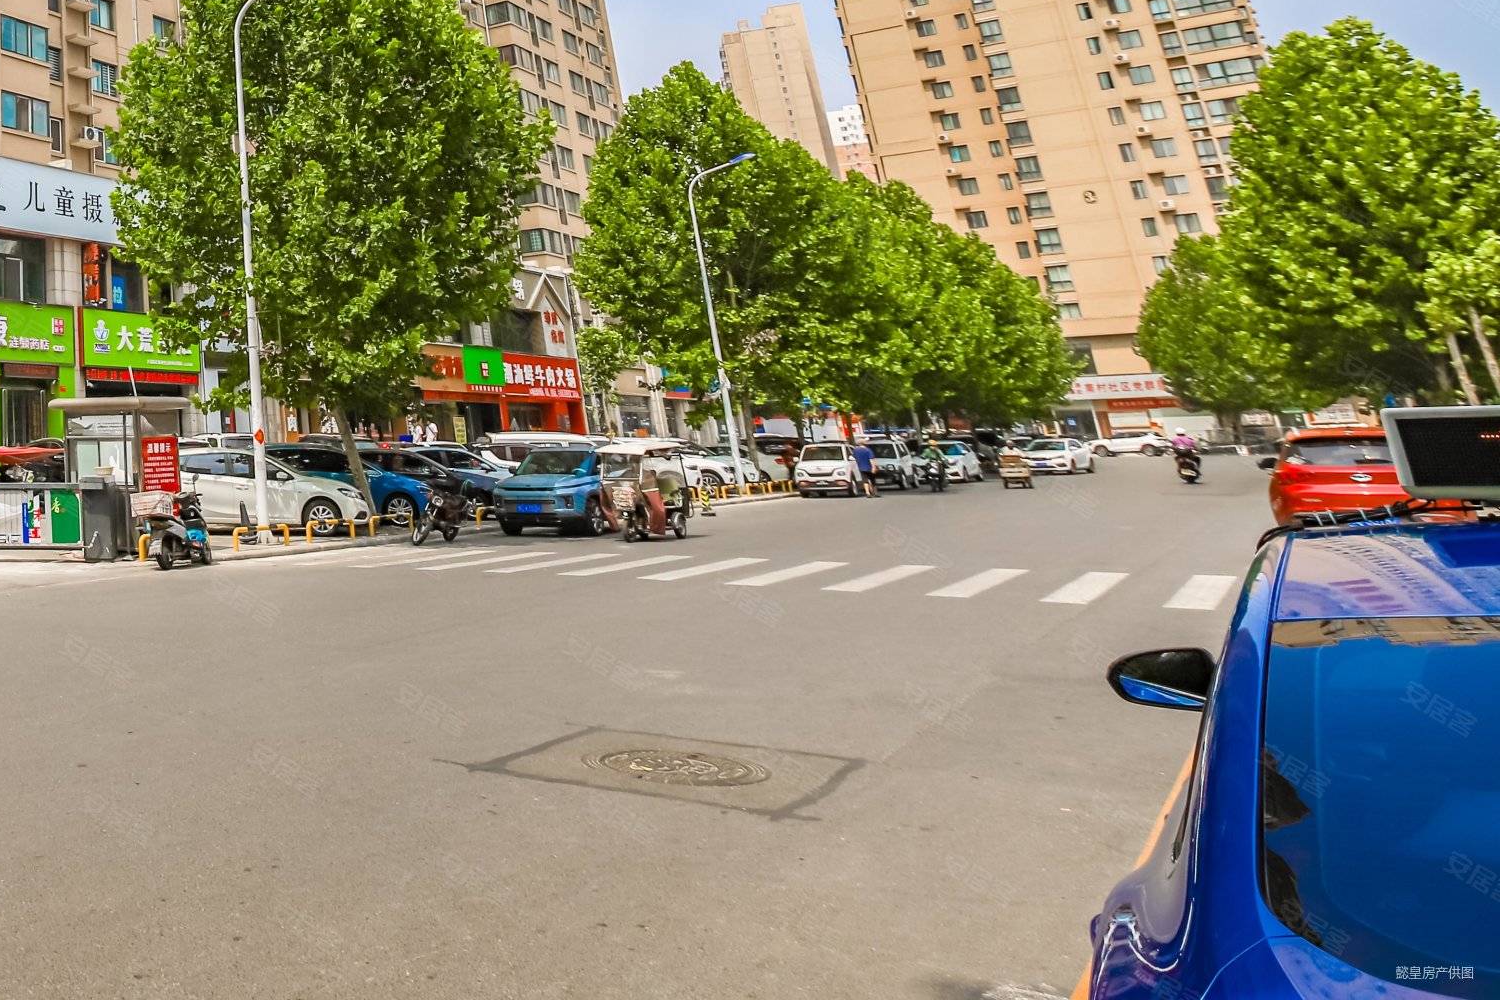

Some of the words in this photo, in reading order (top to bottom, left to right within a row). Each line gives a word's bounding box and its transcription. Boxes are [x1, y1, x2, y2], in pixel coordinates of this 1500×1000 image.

[23, 181, 123, 226] 儿童摄
[147, 443, 171, 454] 温馨提示
